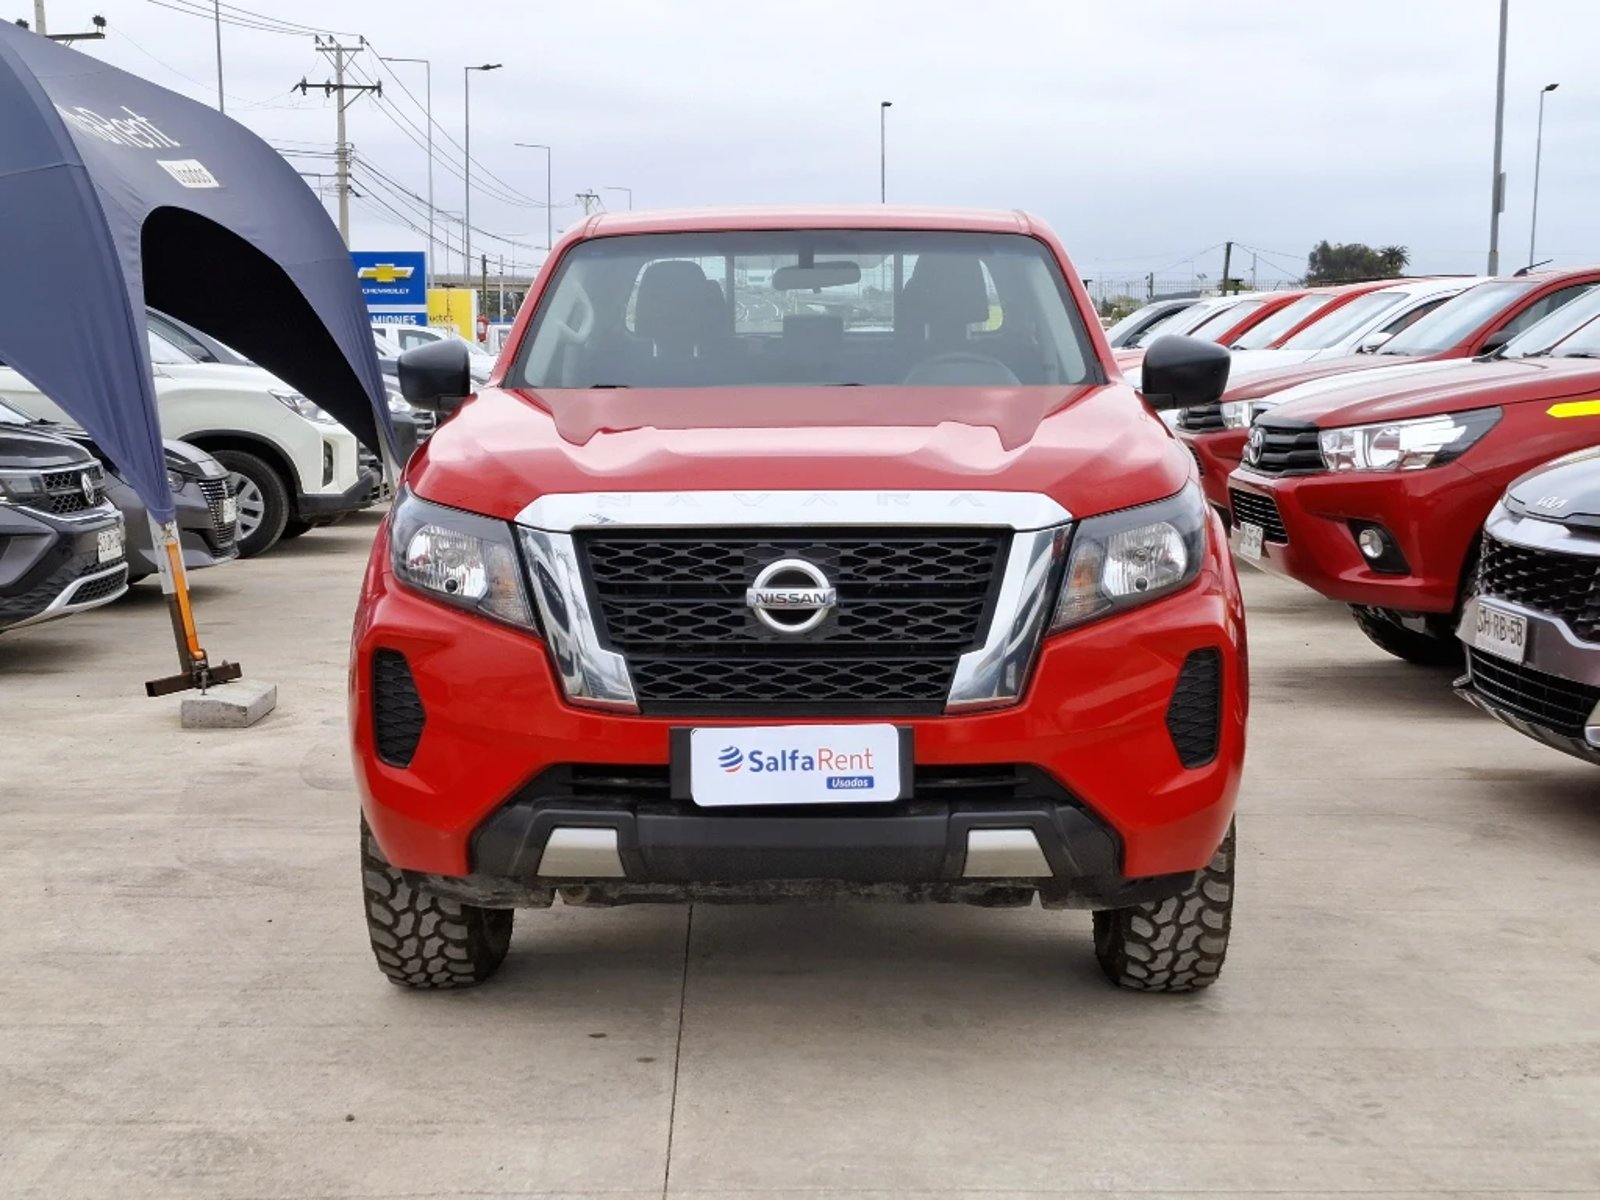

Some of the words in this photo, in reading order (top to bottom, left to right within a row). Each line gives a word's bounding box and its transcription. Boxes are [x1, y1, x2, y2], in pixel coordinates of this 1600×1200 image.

[596, 493, 985, 508] NAVARA
[755, 593, 826, 604] NISSAN
[749, 748, 874, 773] SalfaRent
[832, 779, 868, 788] Usados
